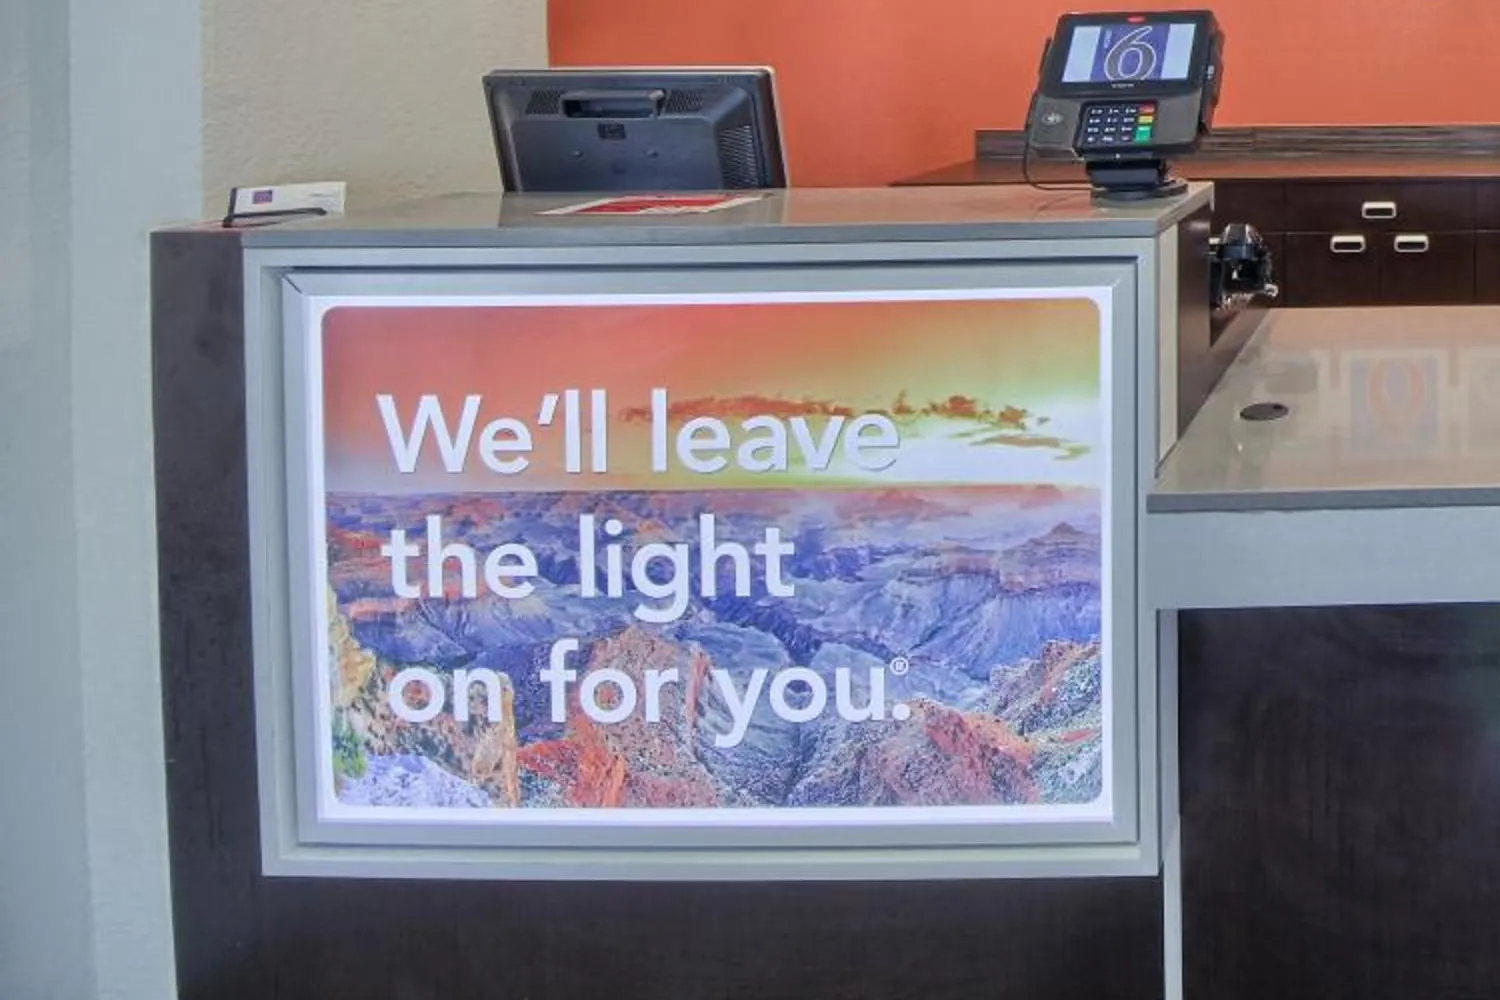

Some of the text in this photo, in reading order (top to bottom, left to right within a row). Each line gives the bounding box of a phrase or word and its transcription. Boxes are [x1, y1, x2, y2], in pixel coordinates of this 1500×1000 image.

[1103, 25, 1157, 81] 6
[376, 388, 902, 474] We'll leave
[382, 514, 796, 623] the light
[388, 666, 504, 724] on
[540, 638, 680, 724] for
